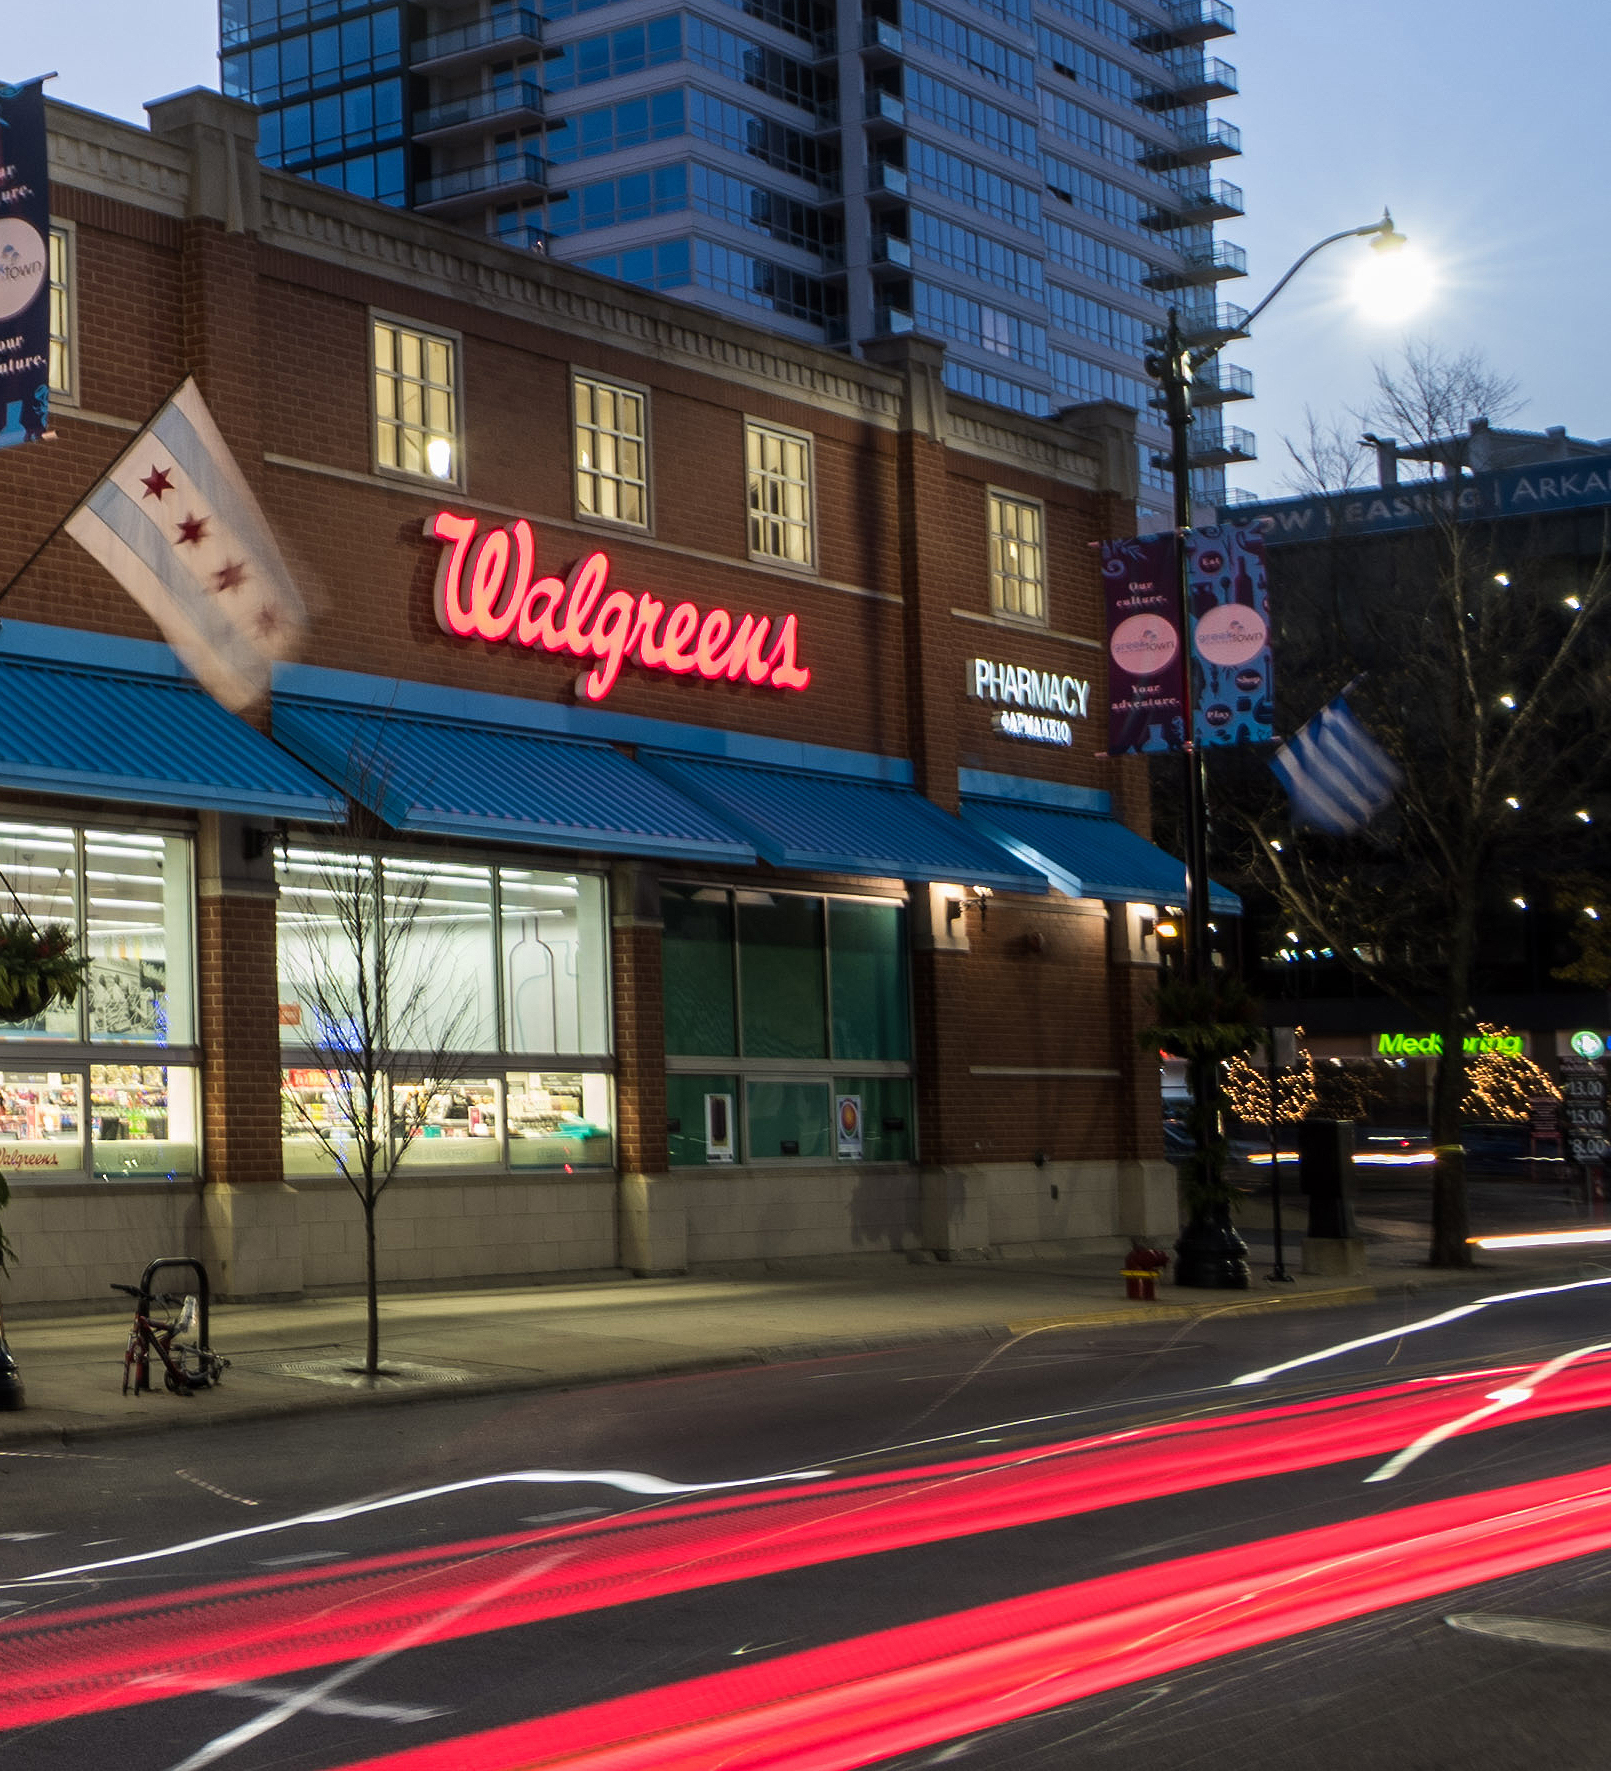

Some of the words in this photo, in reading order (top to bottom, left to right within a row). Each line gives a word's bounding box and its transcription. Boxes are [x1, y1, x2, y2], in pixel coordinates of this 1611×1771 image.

[1325, 483, 1481, 527] LEASING
[1512, 470, 1611, 503] ARKA
[1116, 594, 1168, 607] culture.
[1128, 581, 1154, 591] Our
[434, 511, 811, 702] Walgreens
[975, 658, 1090, 719] PHARMACY
[1131, 684, 1161, 695] Your
